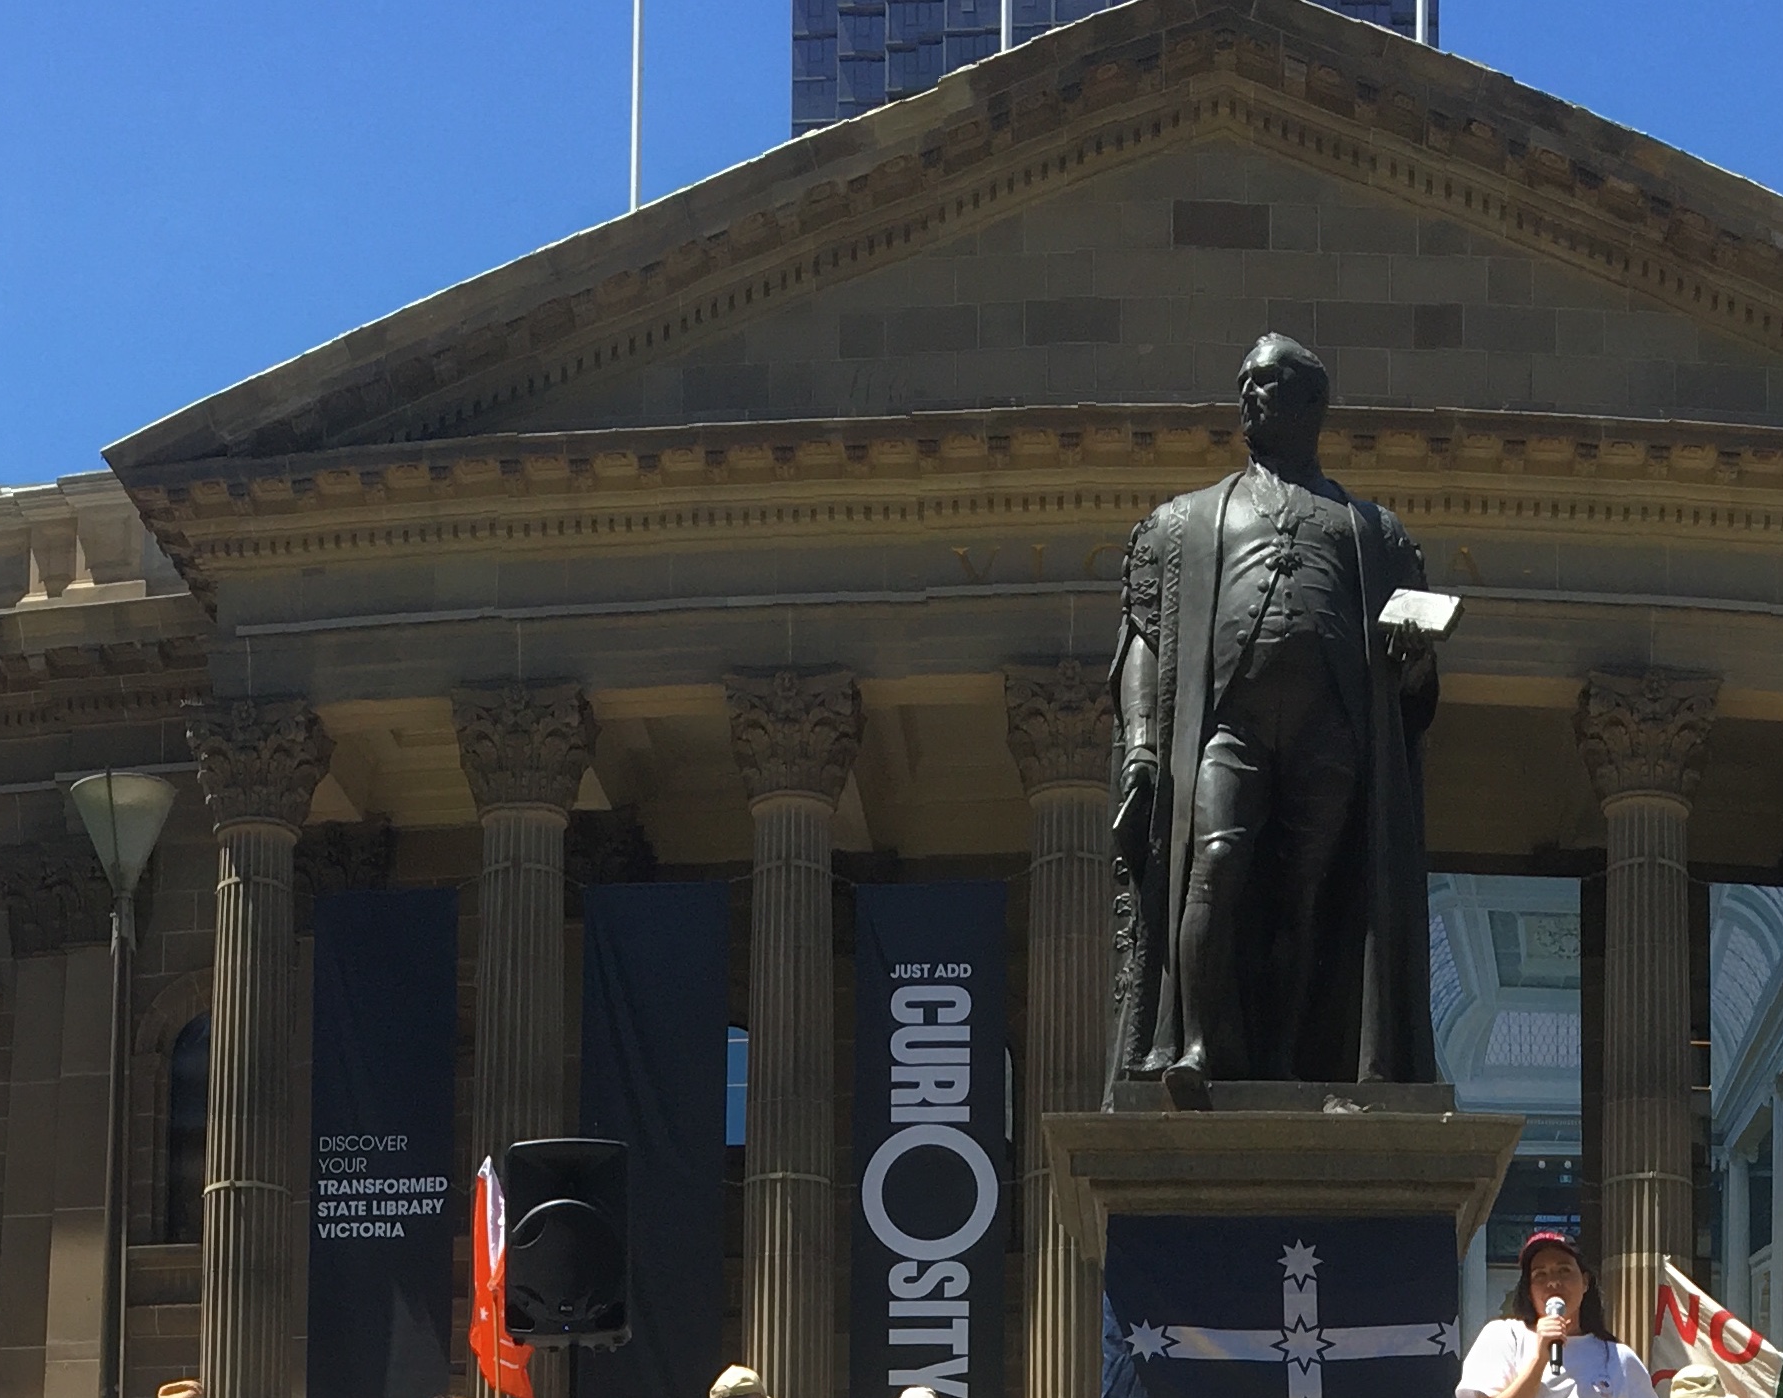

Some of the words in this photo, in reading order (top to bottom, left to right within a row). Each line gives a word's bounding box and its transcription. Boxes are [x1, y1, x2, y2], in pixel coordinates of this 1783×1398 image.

[890, 963, 932, 979] JUST
[934, 963, 972, 979] ADD
[319, 1135, 408, 1152] DISCOVER
[318, 1157, 367, 1173] YOUR
[318, 1177, 448, 1195] TRANSFORMED
[318, 1201, 367, 1217] STATE
[372, 1199, 444, 1216] LIBRARY
[318, 1222, 405, 1238] VICTORIA
[1654, 1283, 1764, 1364] NO
